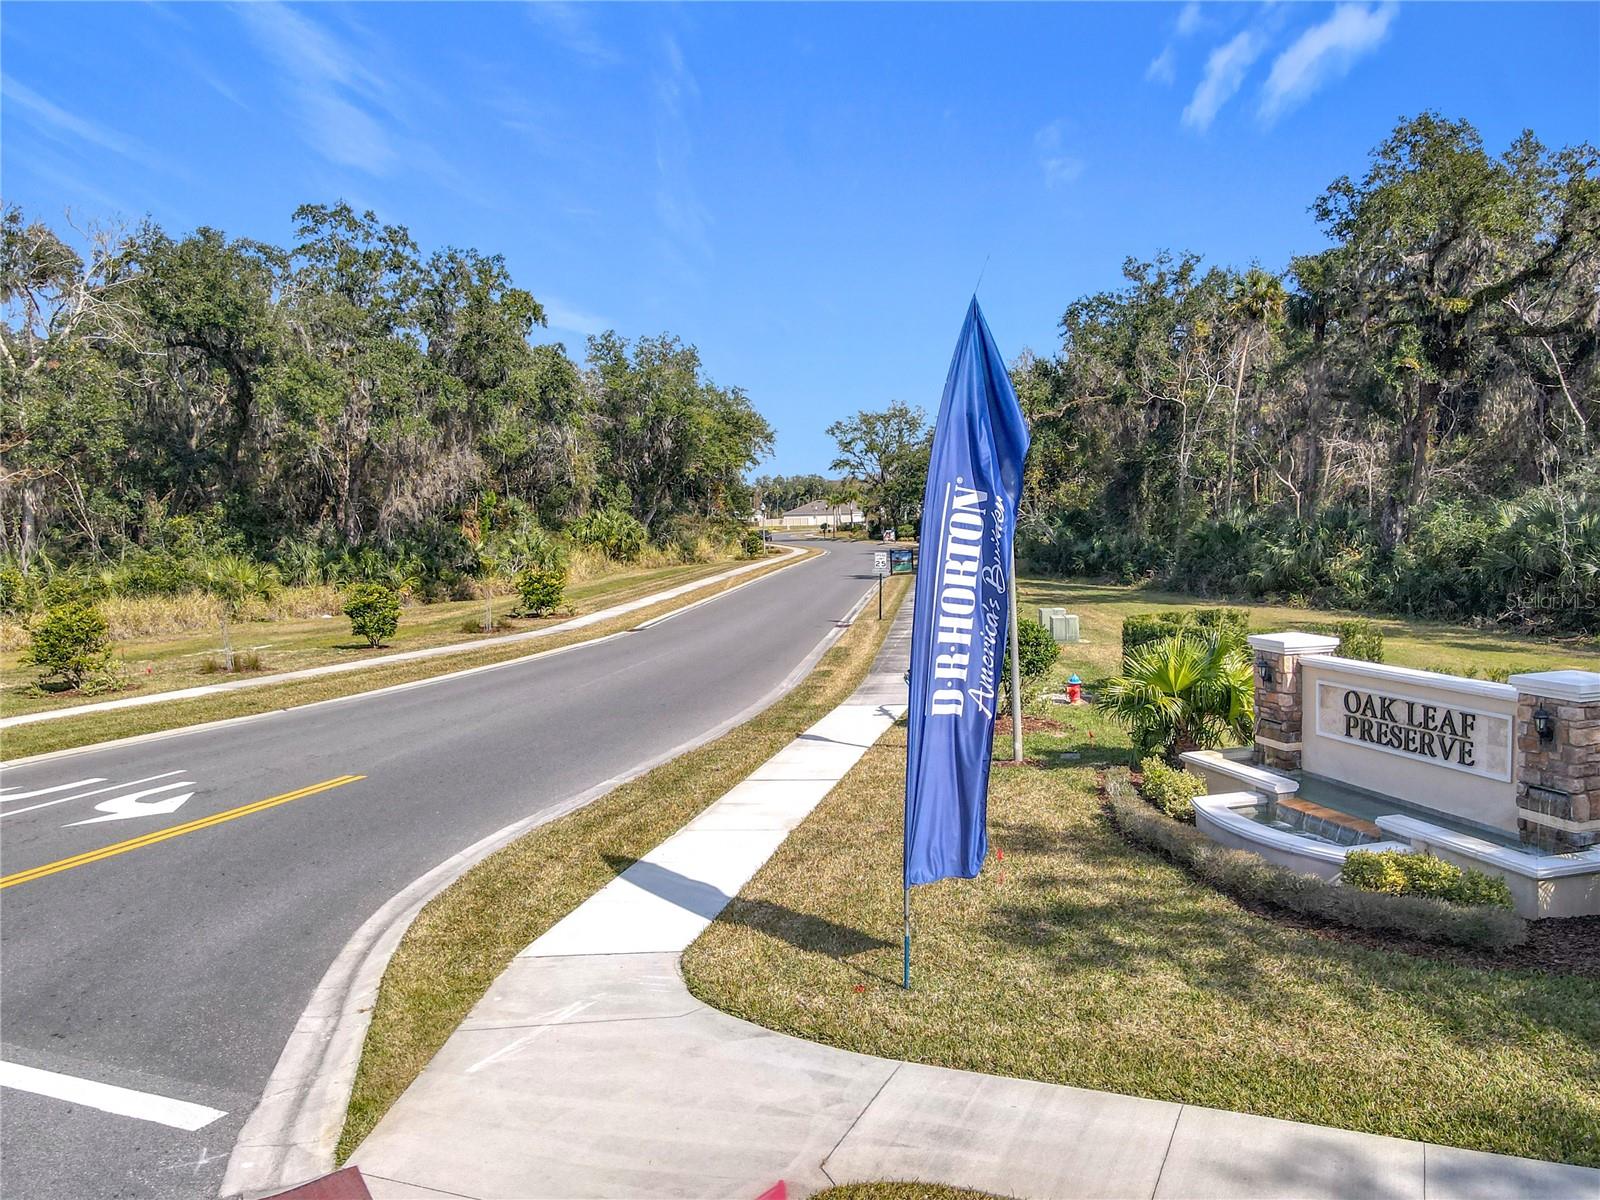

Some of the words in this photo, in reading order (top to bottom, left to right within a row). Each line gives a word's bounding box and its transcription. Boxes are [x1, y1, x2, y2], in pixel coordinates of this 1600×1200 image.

[968, 597, 1001, 720] America's
[1343, 690, 1397, 723] OAK
[1405, 701, 1476, 739] LEAF
[1344, 714, 1475, 767] PRESERVE
